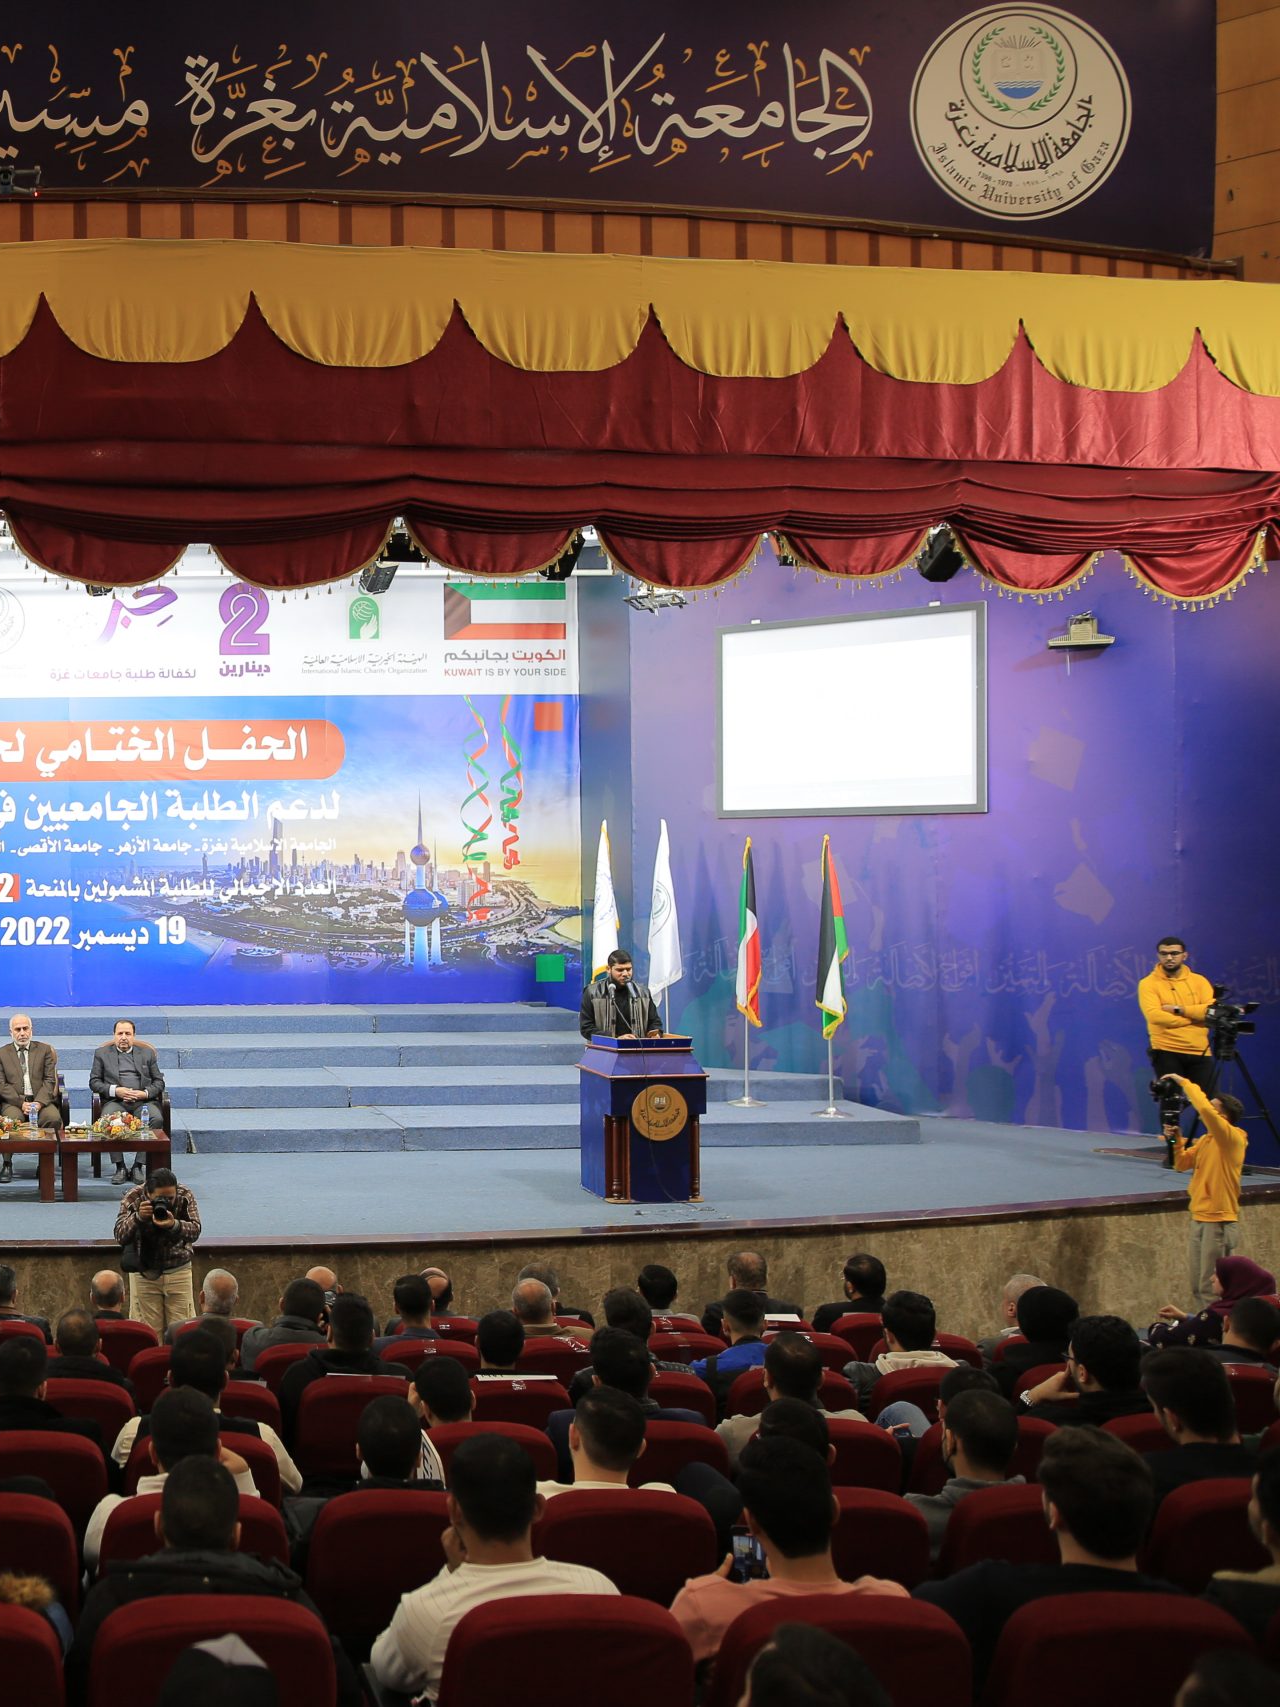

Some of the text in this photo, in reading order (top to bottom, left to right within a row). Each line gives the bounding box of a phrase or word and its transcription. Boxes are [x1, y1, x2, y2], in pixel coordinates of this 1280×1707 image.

[175, 54, 318, 163] بغزة
[320, 32, 665, 165] الإسلامية
[636, 43, 873, 159] الجامعة
[927, 140, 1111, 206] Islamic University of Gaza
[218, 582, 270, 655] 2
[218, 660, 271, 678] دينارين
[443, 649, 566, 664] الكويت بجانبكم
[73, 669, 122, 682] جامعات
[125, 667, 156, 682] طلبة
[158, 668, 196, 679] لكفالة
[363, 667, 386, 675] Charity
[387, 667, 428, 675] Organization
[444, 668, 567, 677] KUWAIT IS BY YOUR SIDE
[35, 725, 175, 778] الختامي
[184, 724, 308, 771] الحفل
[23, 789, 158, 832] الجامعيين
[164, 788, 259, 830] الطلبة
[266, 788, 341, 830] لدعم
[63, 839, 103, 857] جامعة
[152, 837, 192, 856] جامعة
[289, 837, 337, 855] الجامعة
[25, 878, 81, 902] بالمنحة
[83, 876, 156, 903] المشمولين
[158, 877, 216, 901] للطلبة
[0, 915, 187, 952] 19 ديسمبر 2022
